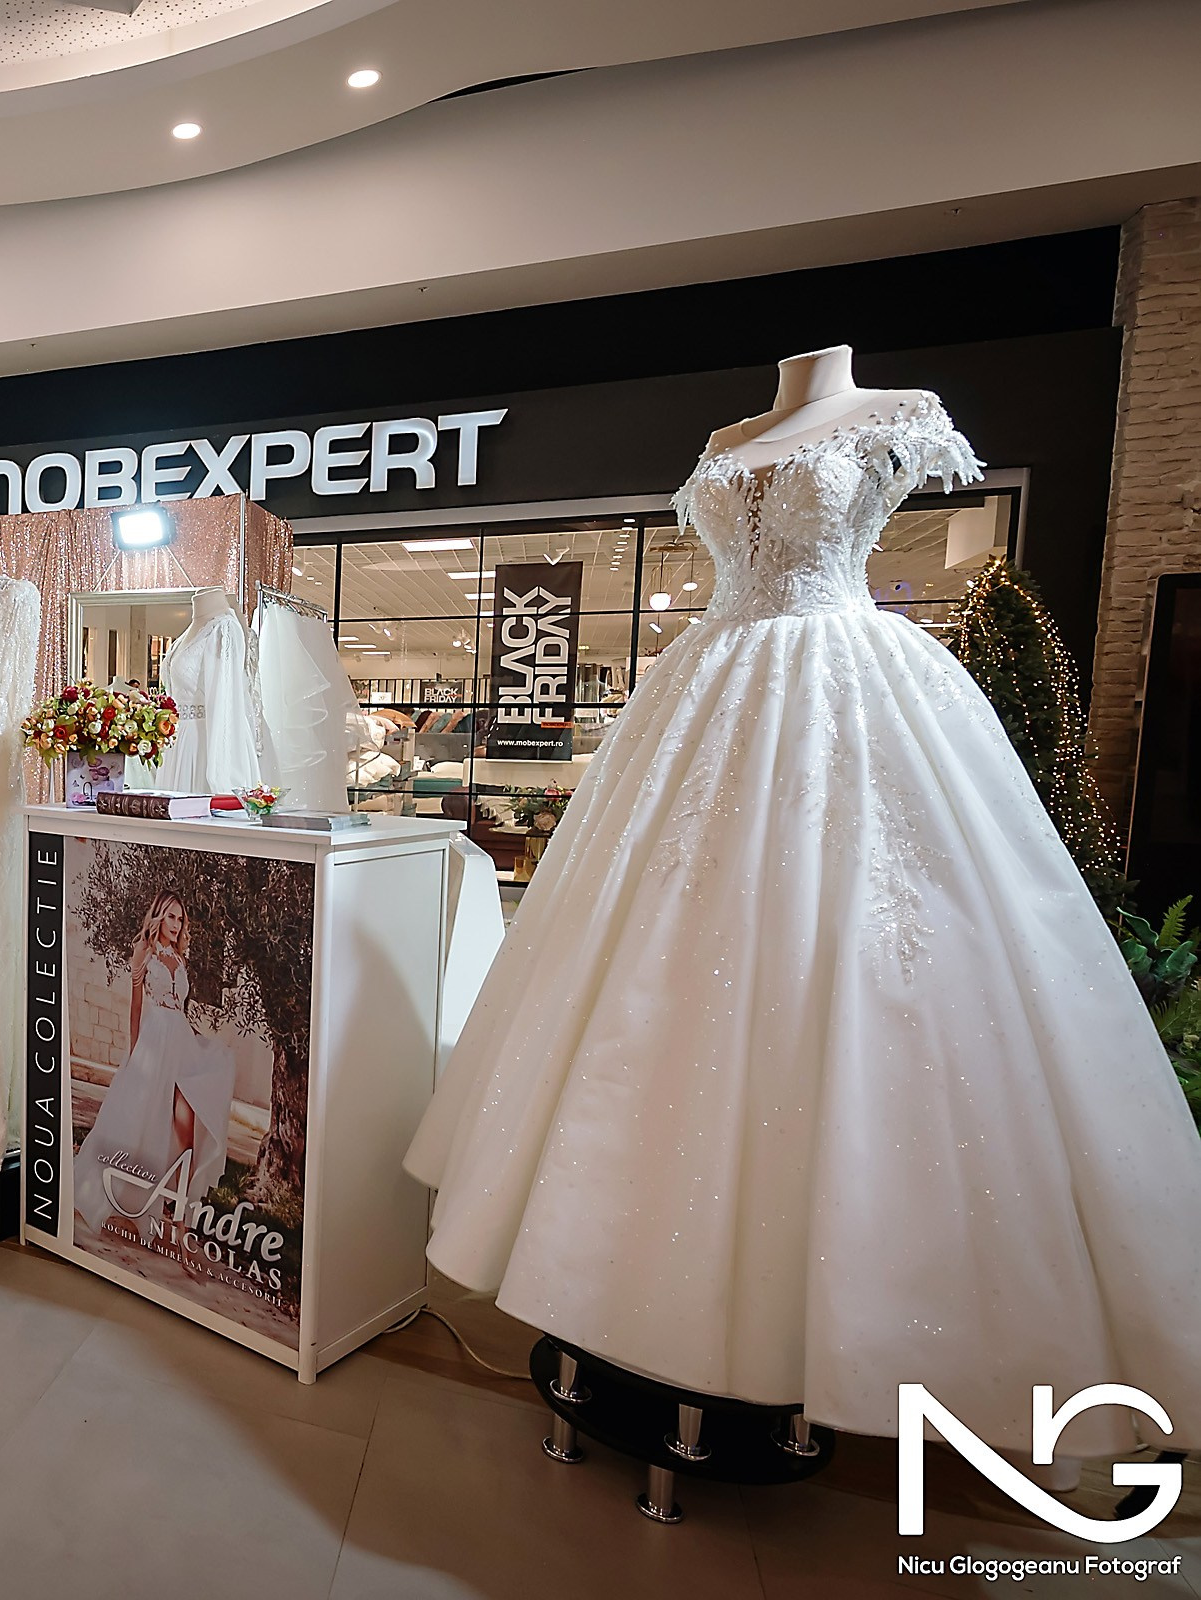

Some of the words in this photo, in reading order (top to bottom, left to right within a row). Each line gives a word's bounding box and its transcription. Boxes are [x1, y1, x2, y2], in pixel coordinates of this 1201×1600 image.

[423, 695, 458, 703] FRIDAY
[424, 687, 459, 696] BLACK
[496, 586, 539, 725] BLACK
[532, 586, 572, 726] FRIDAY
[496, 739, 564, 748] www.mobexpert.ro
[35, 849, 58, 1074] COLECTIE
[33, 1096, 55, 1220] NOUA
[97, 1150, 157, 1183] collection
[102, 1148, 284, 1262] Andre
[101, 1221, 137, 1243] ROCHII
[140, 1239, 153, 1250] DE
[156, 1245, 203, 1271] MIREASA
[206, 1267, 214, 1277] &
[217, 1273, 283, 1308] ACCESORII
[149, 1215, 282, 1290] NICOLAS
